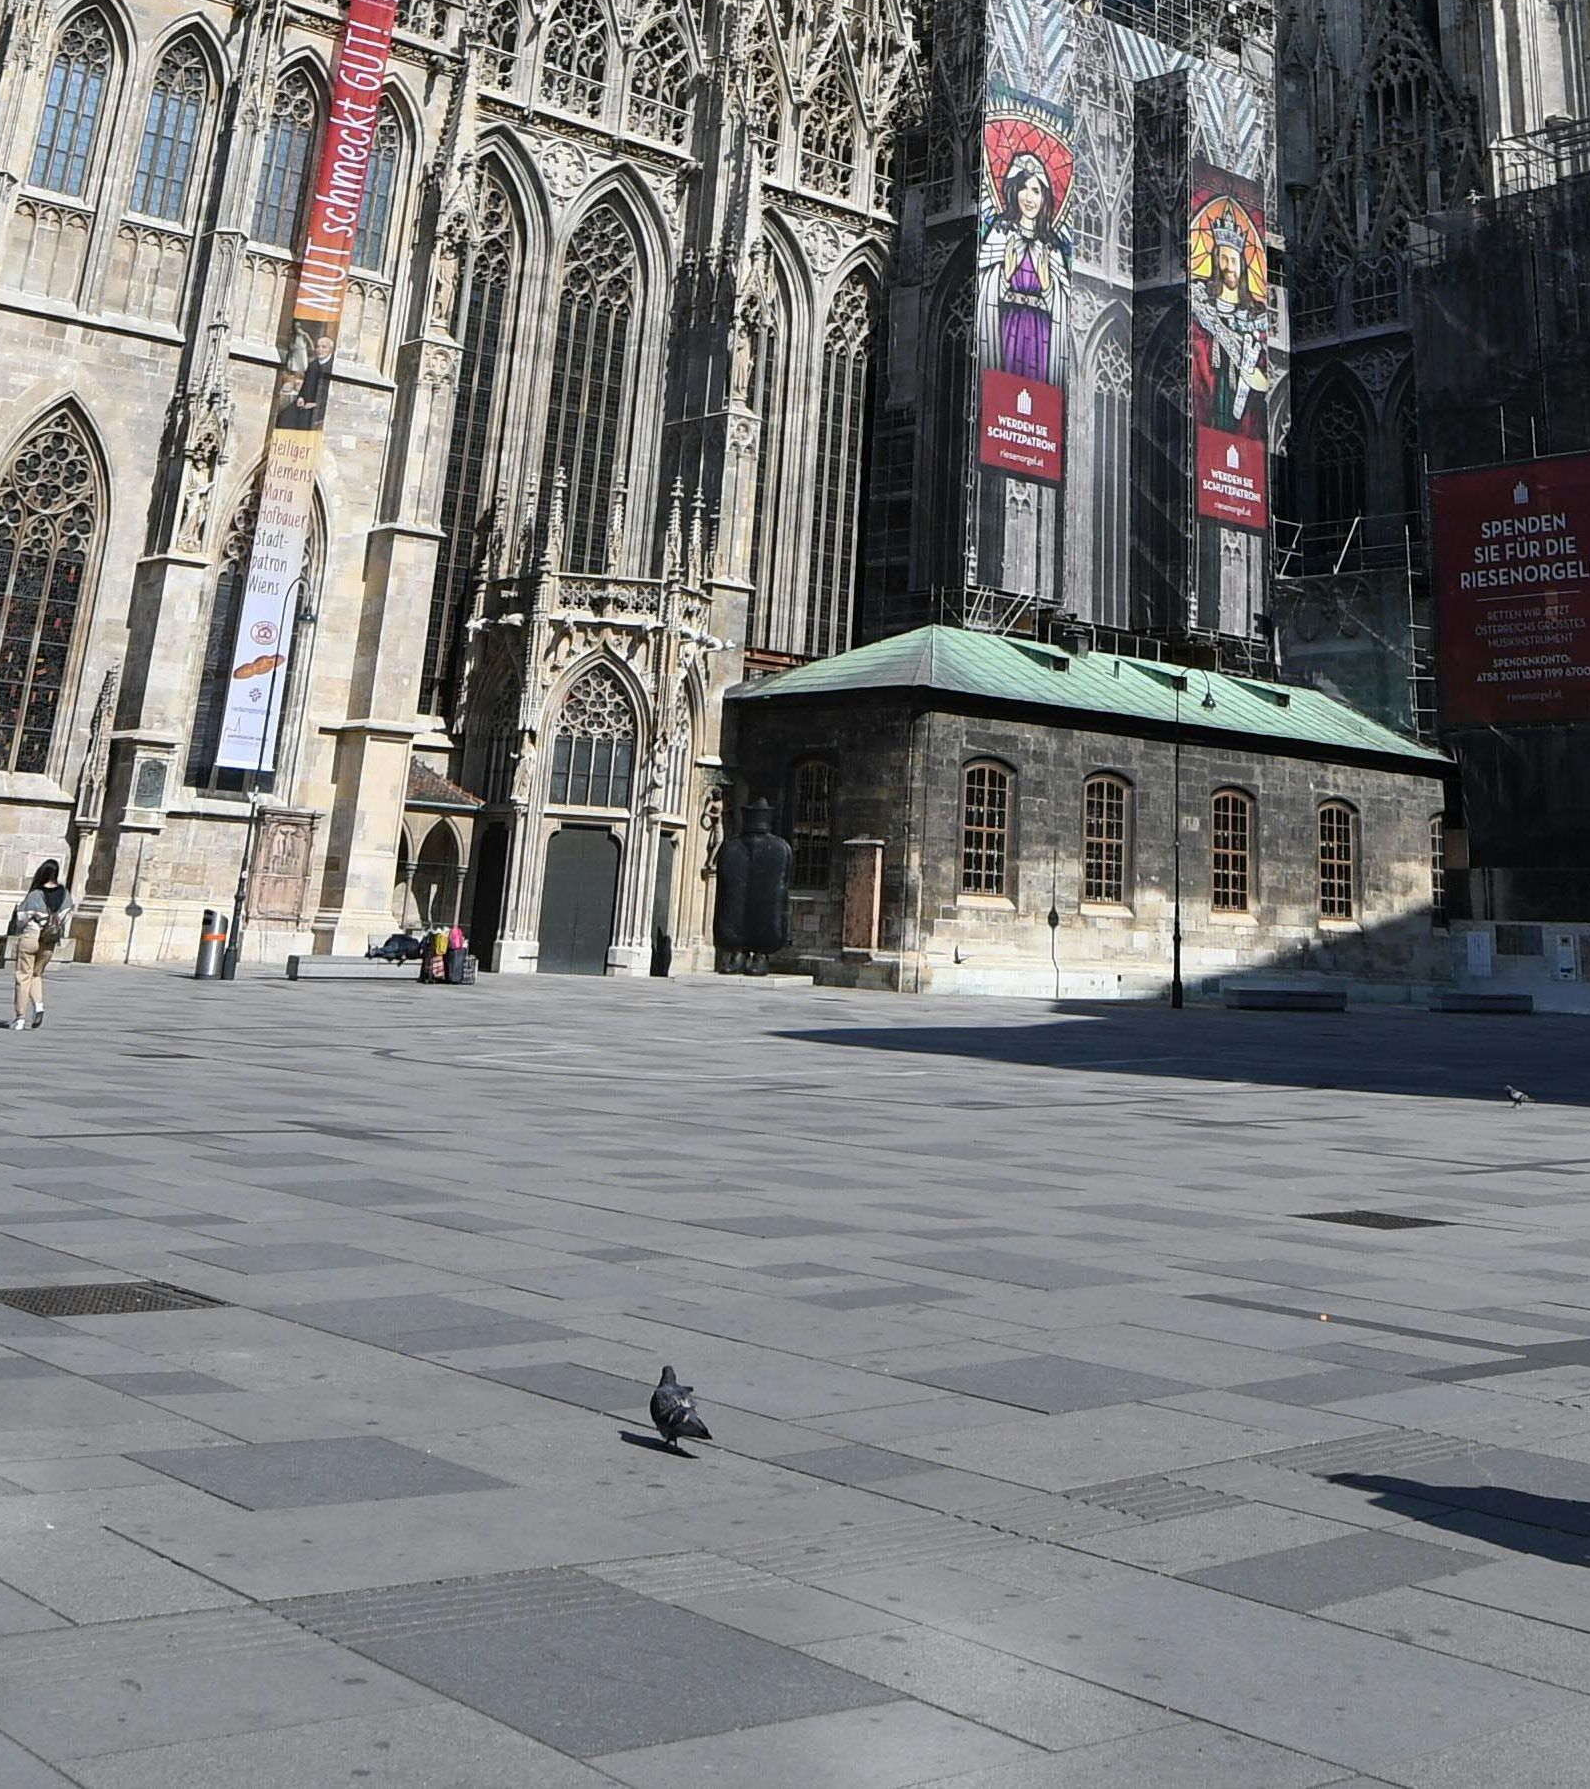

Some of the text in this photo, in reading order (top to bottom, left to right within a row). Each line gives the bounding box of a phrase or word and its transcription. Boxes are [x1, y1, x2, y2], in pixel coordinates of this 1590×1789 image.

[297, 19, 390, 314] MUT schmeckt GUT!
[997, 414, 1048, 437] WERDEN SIE
[270, 437, 312, 462] Heiliger
[987, 426, 1056, 453] SCHUTZPATRON!
[1000, 449, 1044, 467] riesenorgel.at
[267, 459, 313, 483] Klemens
[1211, 468, 1254, 489] WERDEN SIE
[263, 482, 293, 503] Maria
[259, 504, 308, 529] Hofbauer
[1481, 512, 1567, 539] SPENDEN
[255, 526, 289, 550] Stadt-
[1474, 536, 1577, 564] SIE FÜR DIE
[251, 554, 287, 574] patron
[248, 574, 280, 596] Wiens
[1524, 606, 1544, 618] WIR
[1488, 632, 1573, 648] MUSIKINSTRUMENT
